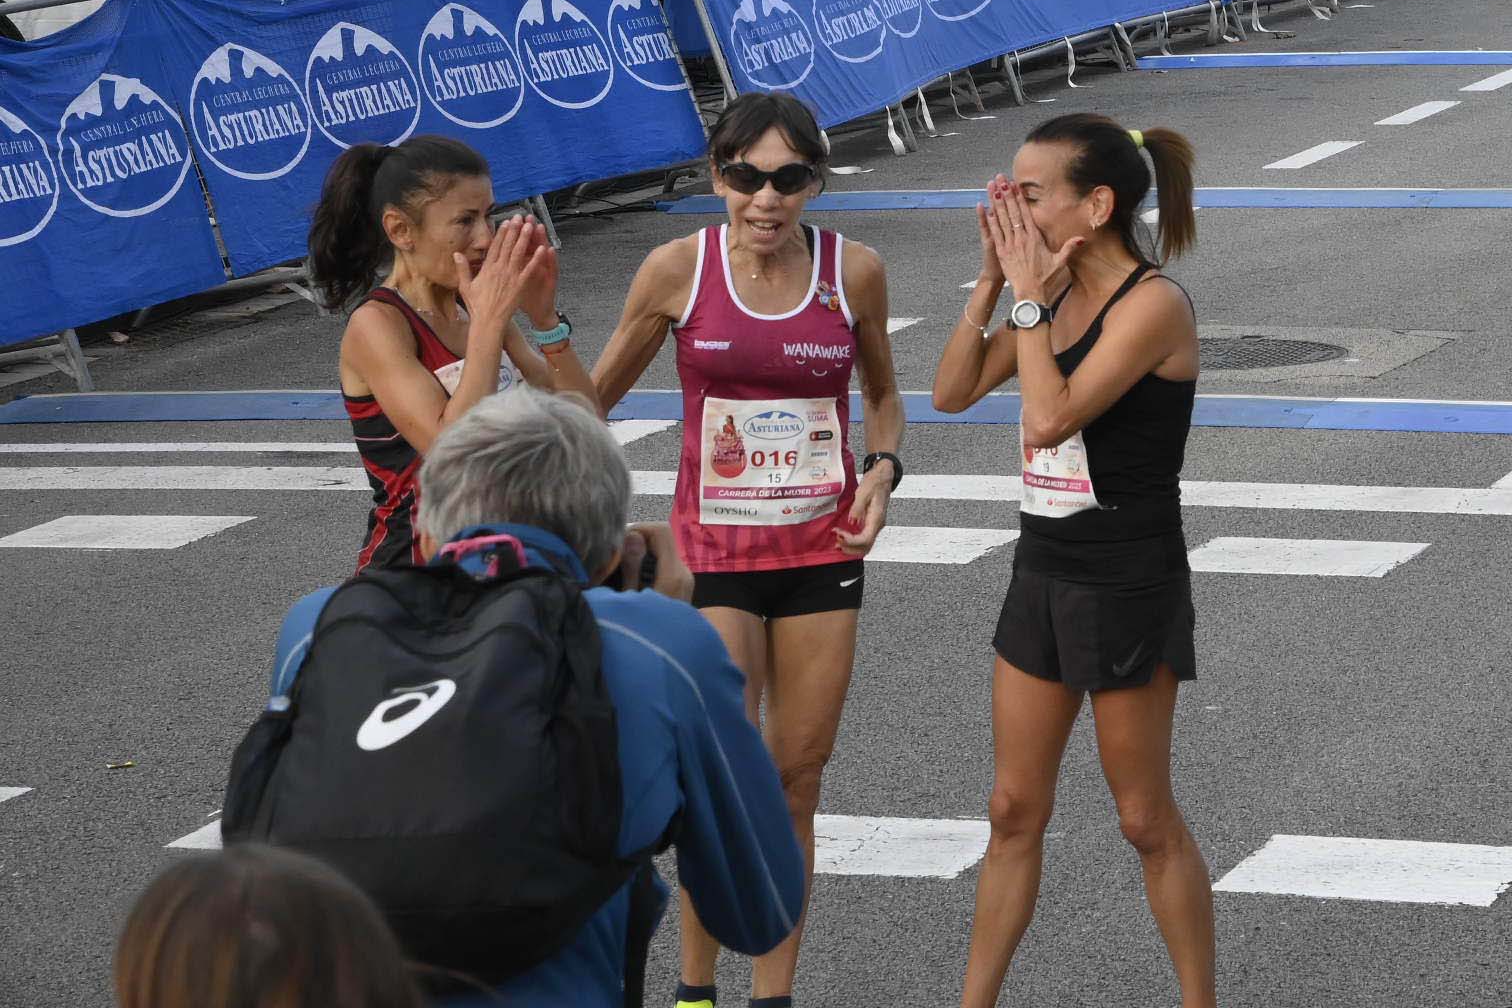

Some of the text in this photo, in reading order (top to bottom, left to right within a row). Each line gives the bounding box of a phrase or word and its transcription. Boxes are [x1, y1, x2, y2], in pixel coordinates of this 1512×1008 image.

[533, 26, 592, 46] CENTRAL LECHERA
[438, 41, 505, 62] CENTRAL LECHERA
[523, 38, 610, 84] ASTURIANA
[326, 59, 401, 85] CENTRAL LECHERA
[428, 53, 520, 102] ASTURIANA
[213, 83, 290, 107] CENTRAL LECHERA
[316, 77, 417, 128] ASTURIANA
[80, 121, 121, 143] CENTRAL
[202, 101, 306, 153] ASTURIANA
[783, 342, 851, 360] WANAWAKE
[747, 420, 801, 434] ASTURIANA
[751, 449, 798, 468] 016
[767, 473, 782, 485] 15
[718, 489, 757, 498] CARRERA
[758, 489, 771, 497] DE
[771, 488, 783, 497] LA
[784, 488, 811, 497] MUJER
